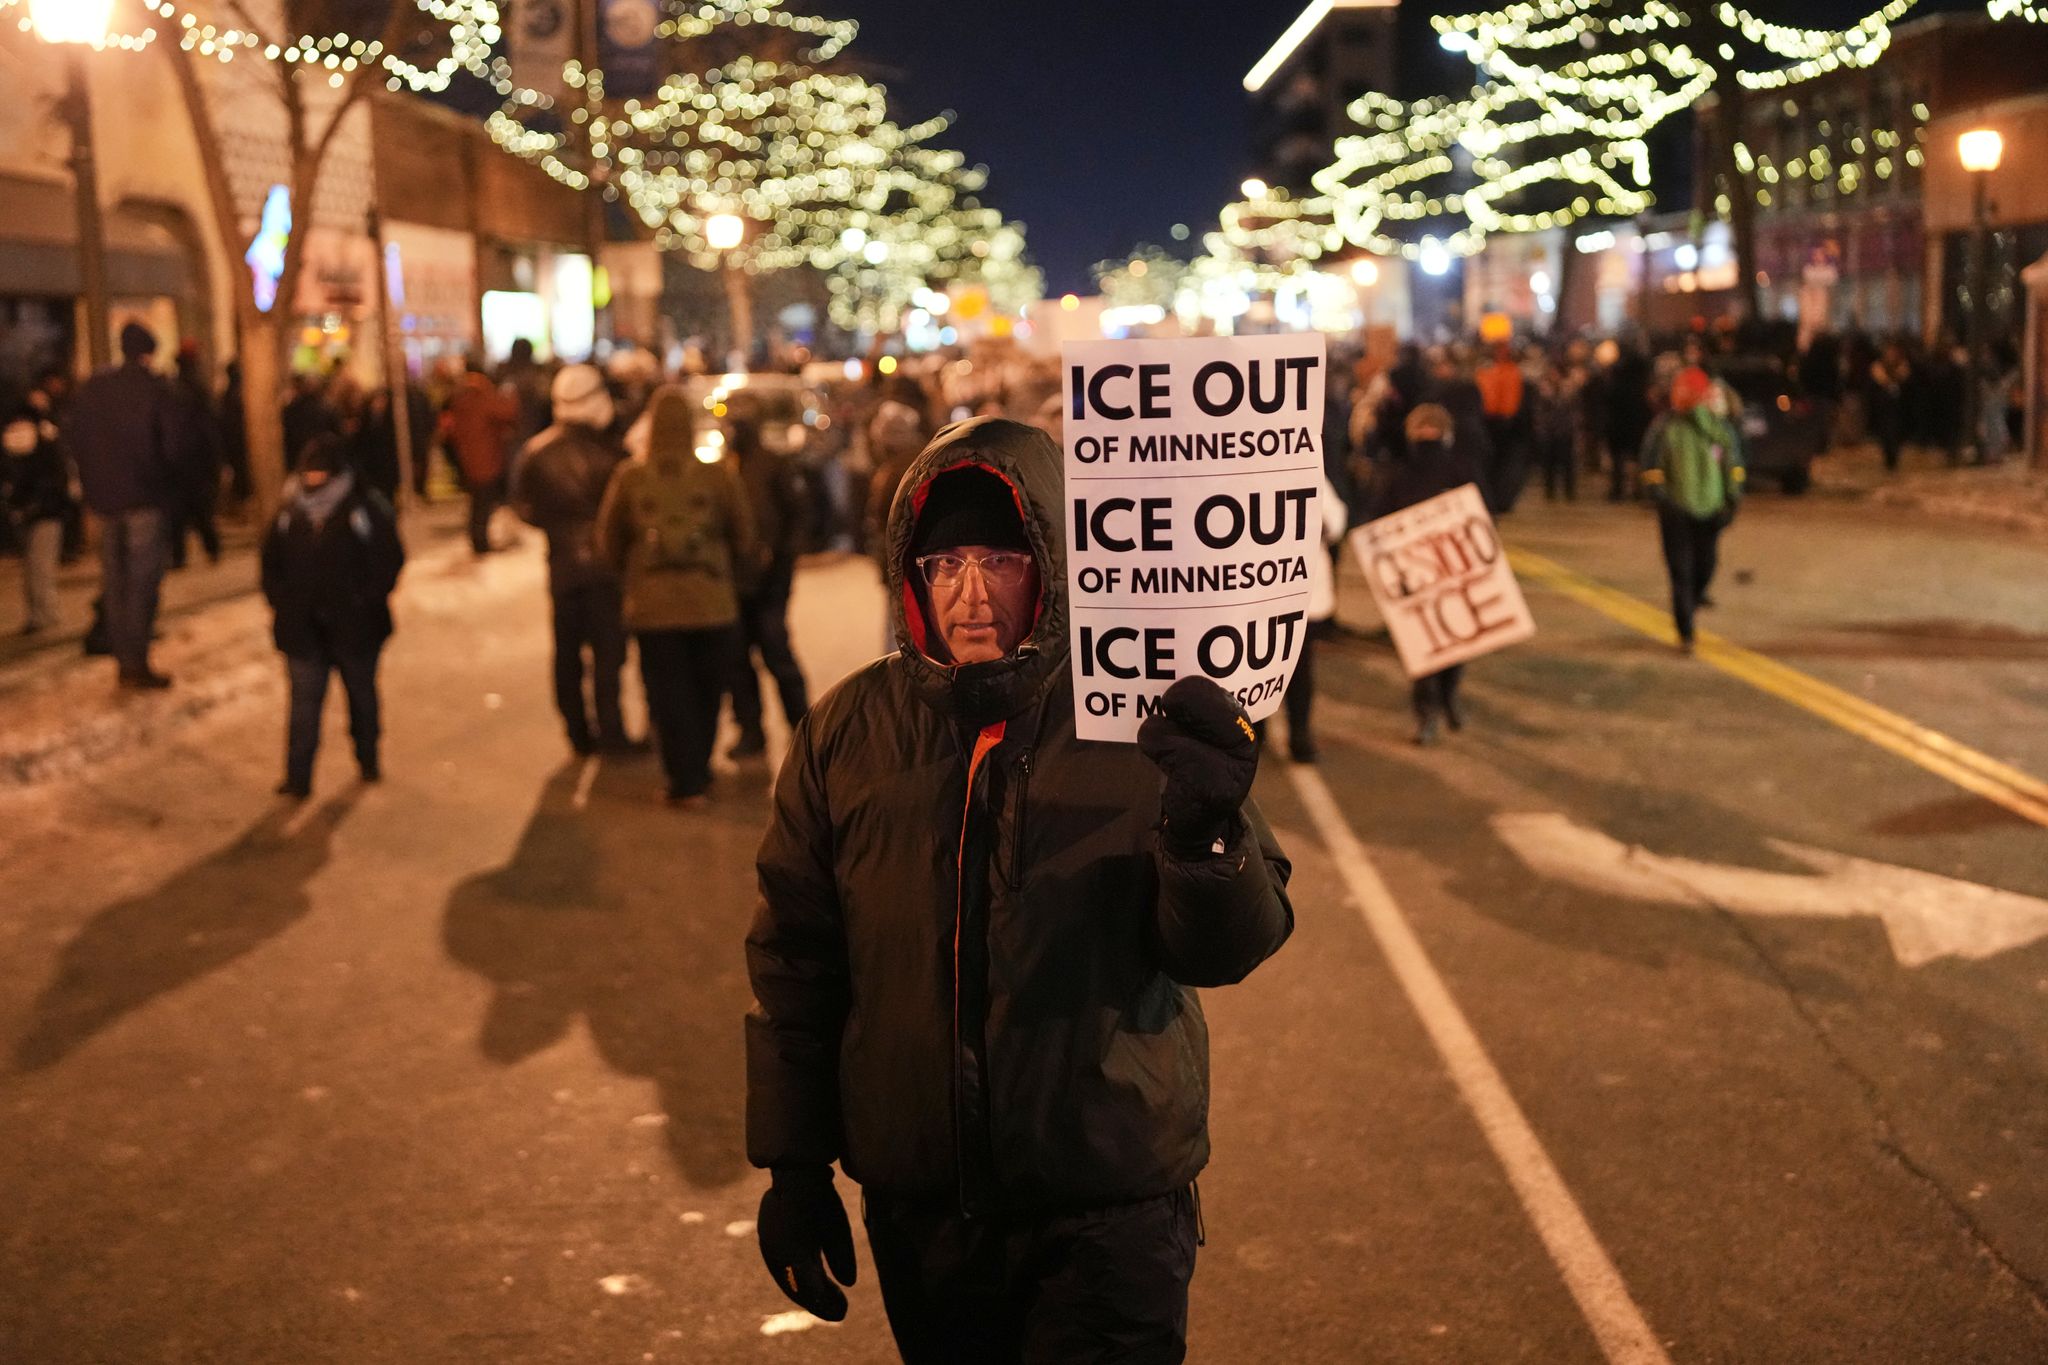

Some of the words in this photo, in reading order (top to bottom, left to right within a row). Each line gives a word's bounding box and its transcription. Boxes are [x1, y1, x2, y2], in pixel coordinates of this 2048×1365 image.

[1071, 364, 1172, 421] ICE
[1192, 356, 1319, 417] OUT
[1074, 436, 1119, 463] OF
[1129, 427, 1315, 463] MINNESOTA
[1074, 497, 1173, 552] ICE
[1193, 487, 1317, 550] OUT
[1077, 567, 1121, 594] OF
[1130, 556, 1308, 594] MINNESOTA
[1080, 626, 1177, 681] ICE
[1196, 610, 1305, 679] OUT
[1085, 692, 1127, 718] OF
[1136, 674, 1284, 719] MSOTA
